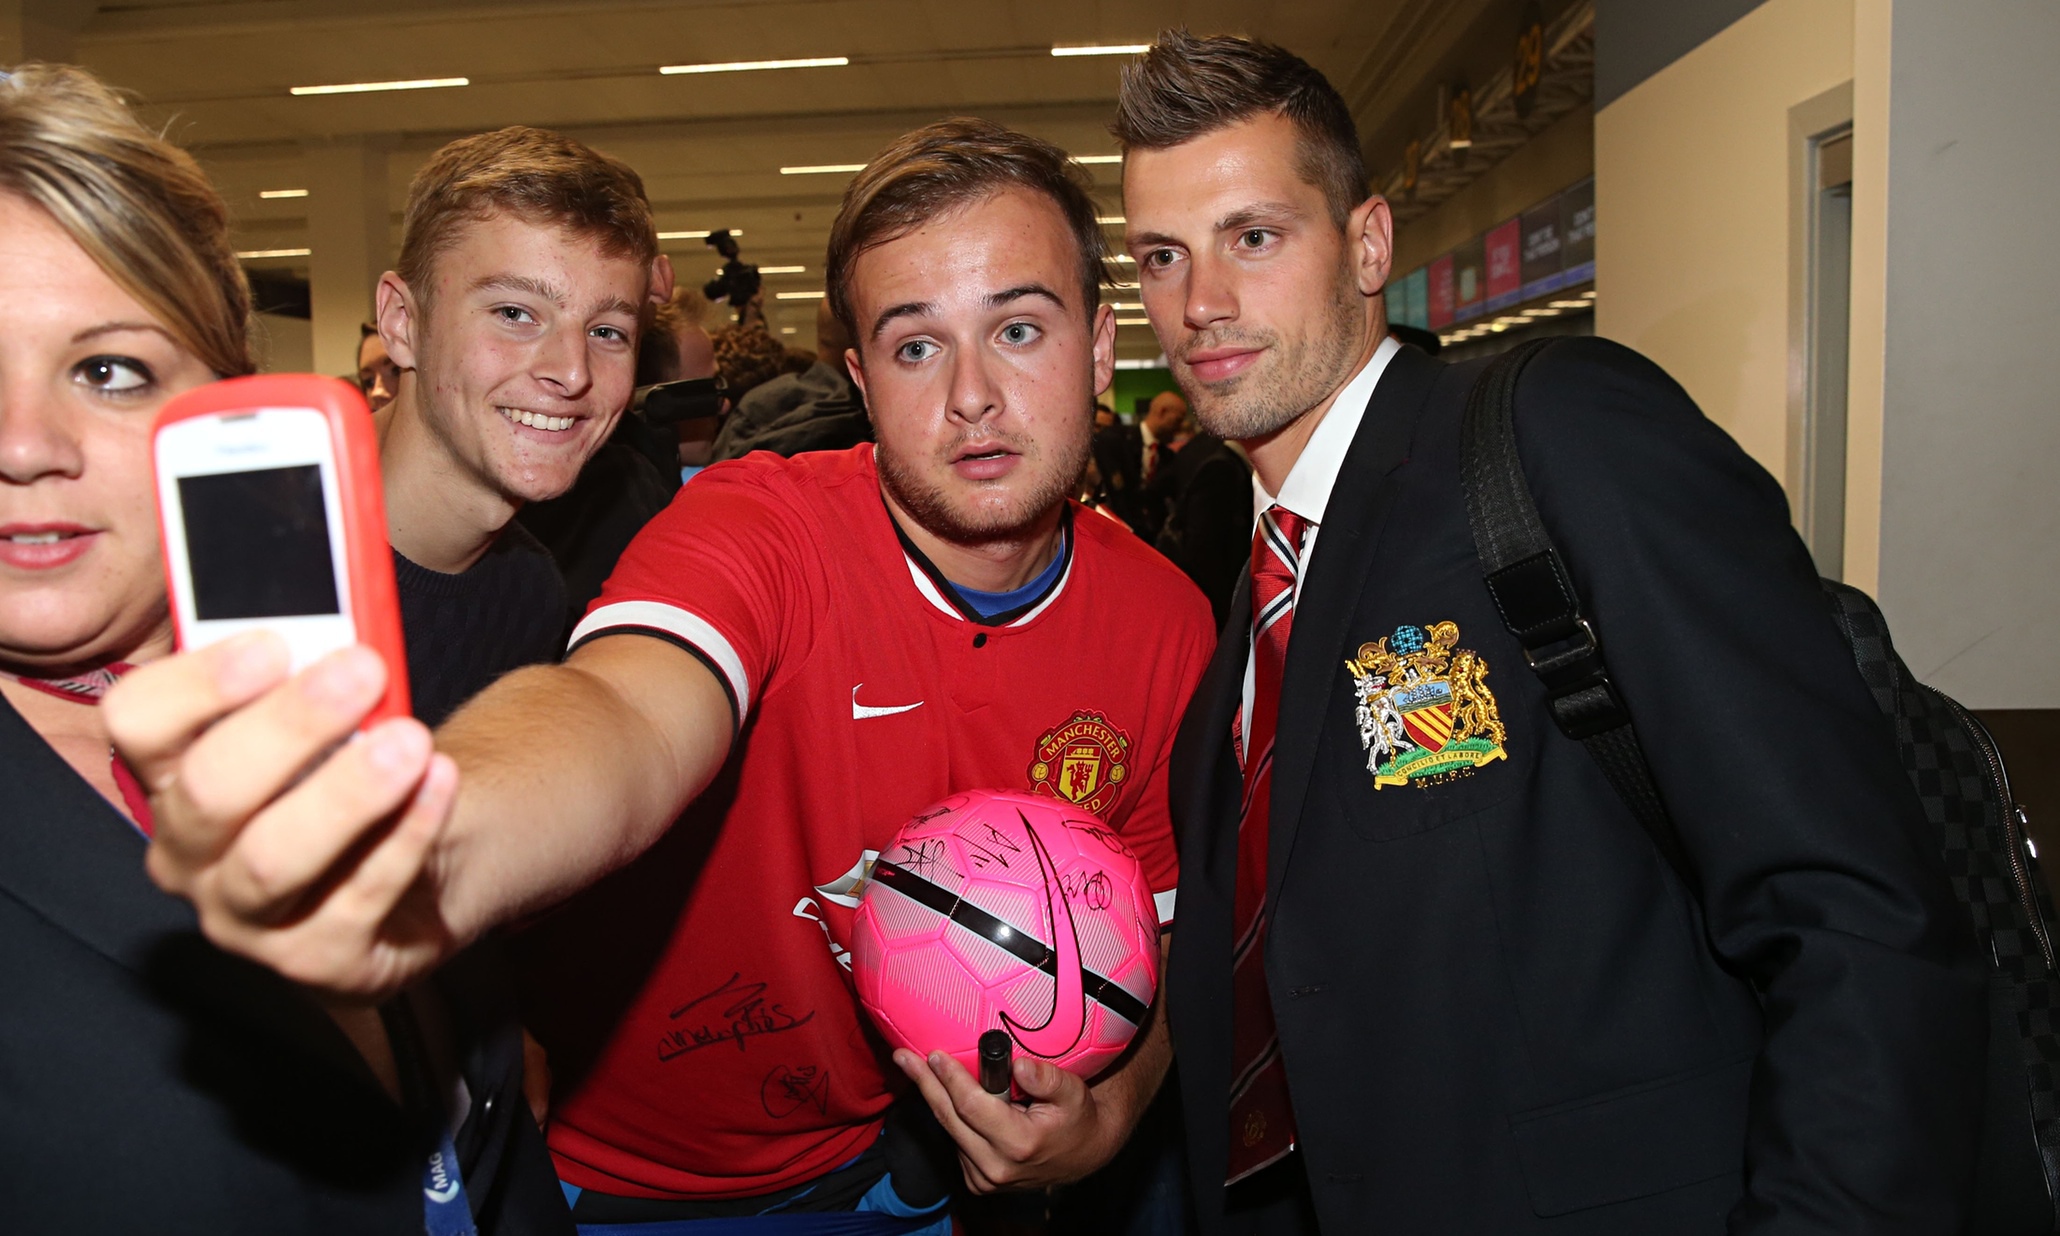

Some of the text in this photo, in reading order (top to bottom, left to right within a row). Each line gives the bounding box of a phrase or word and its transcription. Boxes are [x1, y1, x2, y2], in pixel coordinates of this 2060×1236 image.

[1046, 724, 1120, 758] MANCHESTER
[1397, 752, 1480, 777] CONCILIO ET LABORE
[428, 1152, 449, 1190] MAG
